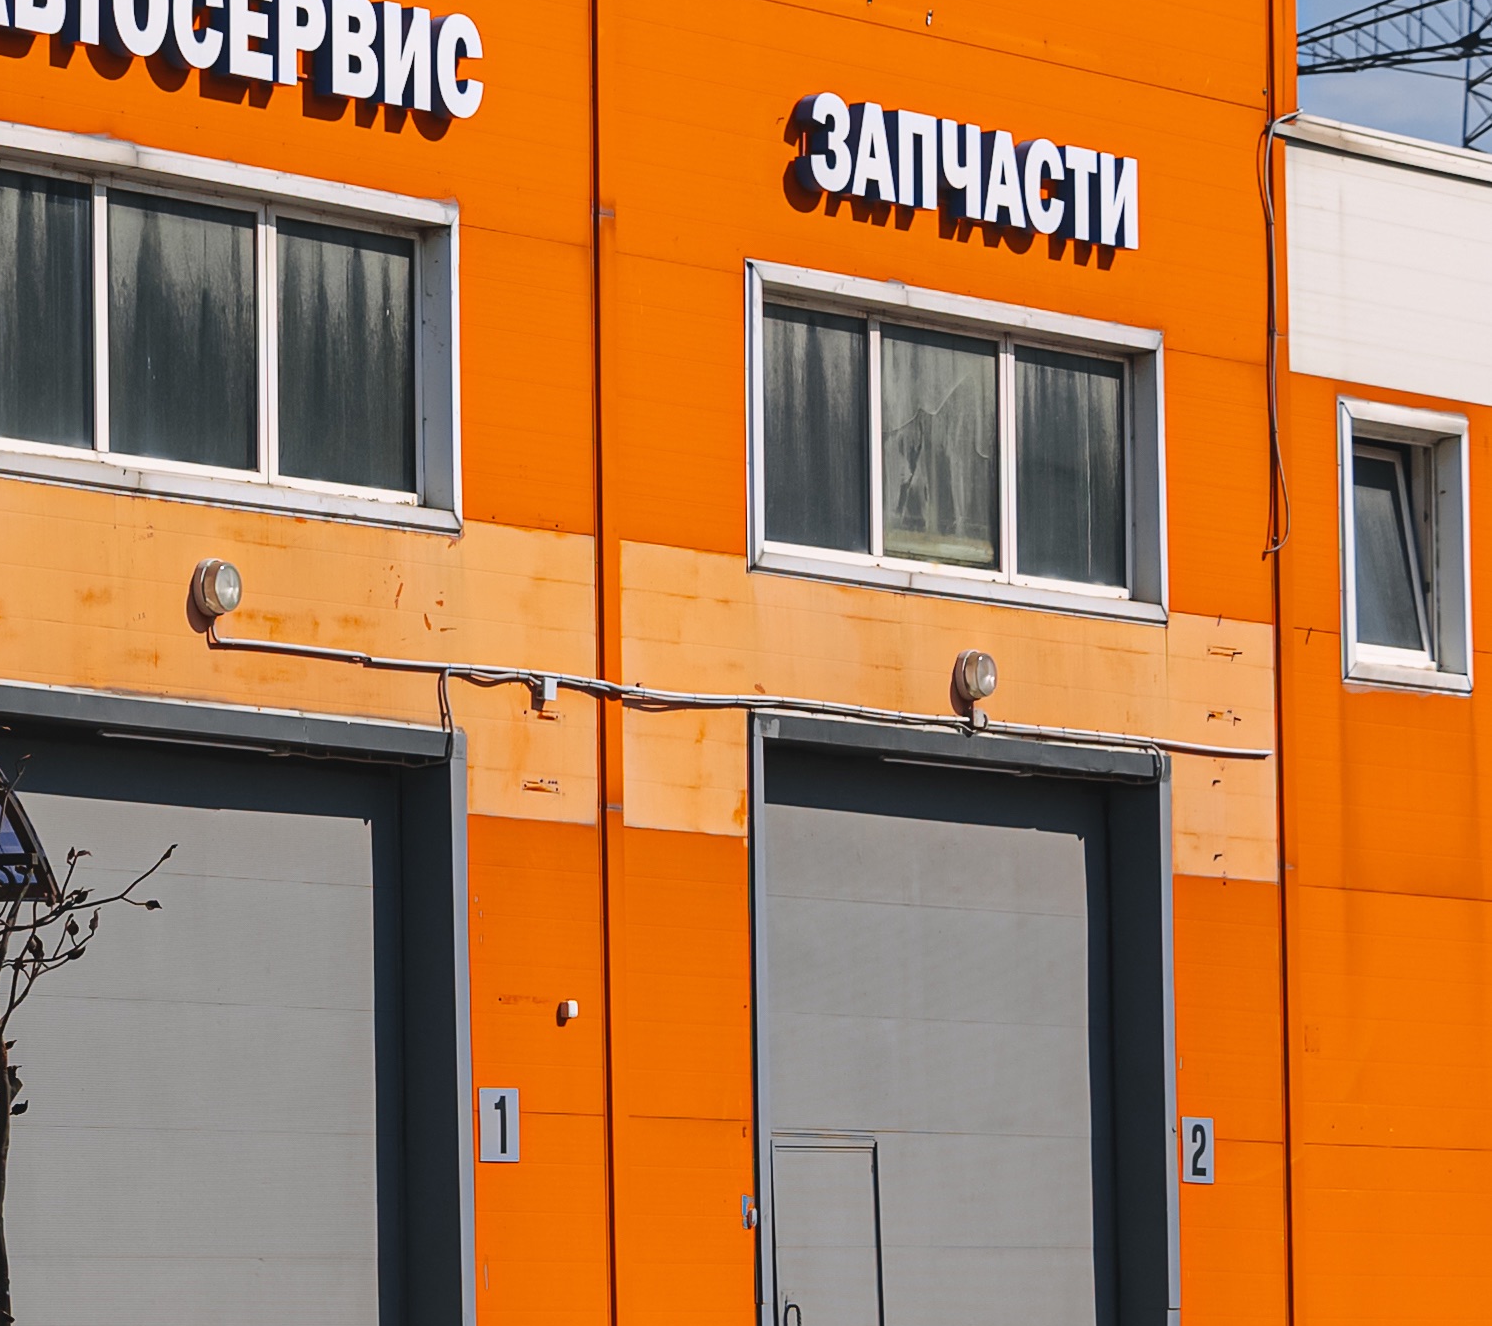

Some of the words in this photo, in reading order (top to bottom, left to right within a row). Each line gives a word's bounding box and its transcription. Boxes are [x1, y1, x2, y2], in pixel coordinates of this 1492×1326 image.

[808, 91, 1140, 251] ЗАПЧАСТИ
[494, 1095, 507, 1154] 1
[1191, 1123, 1207, 1177] 2
